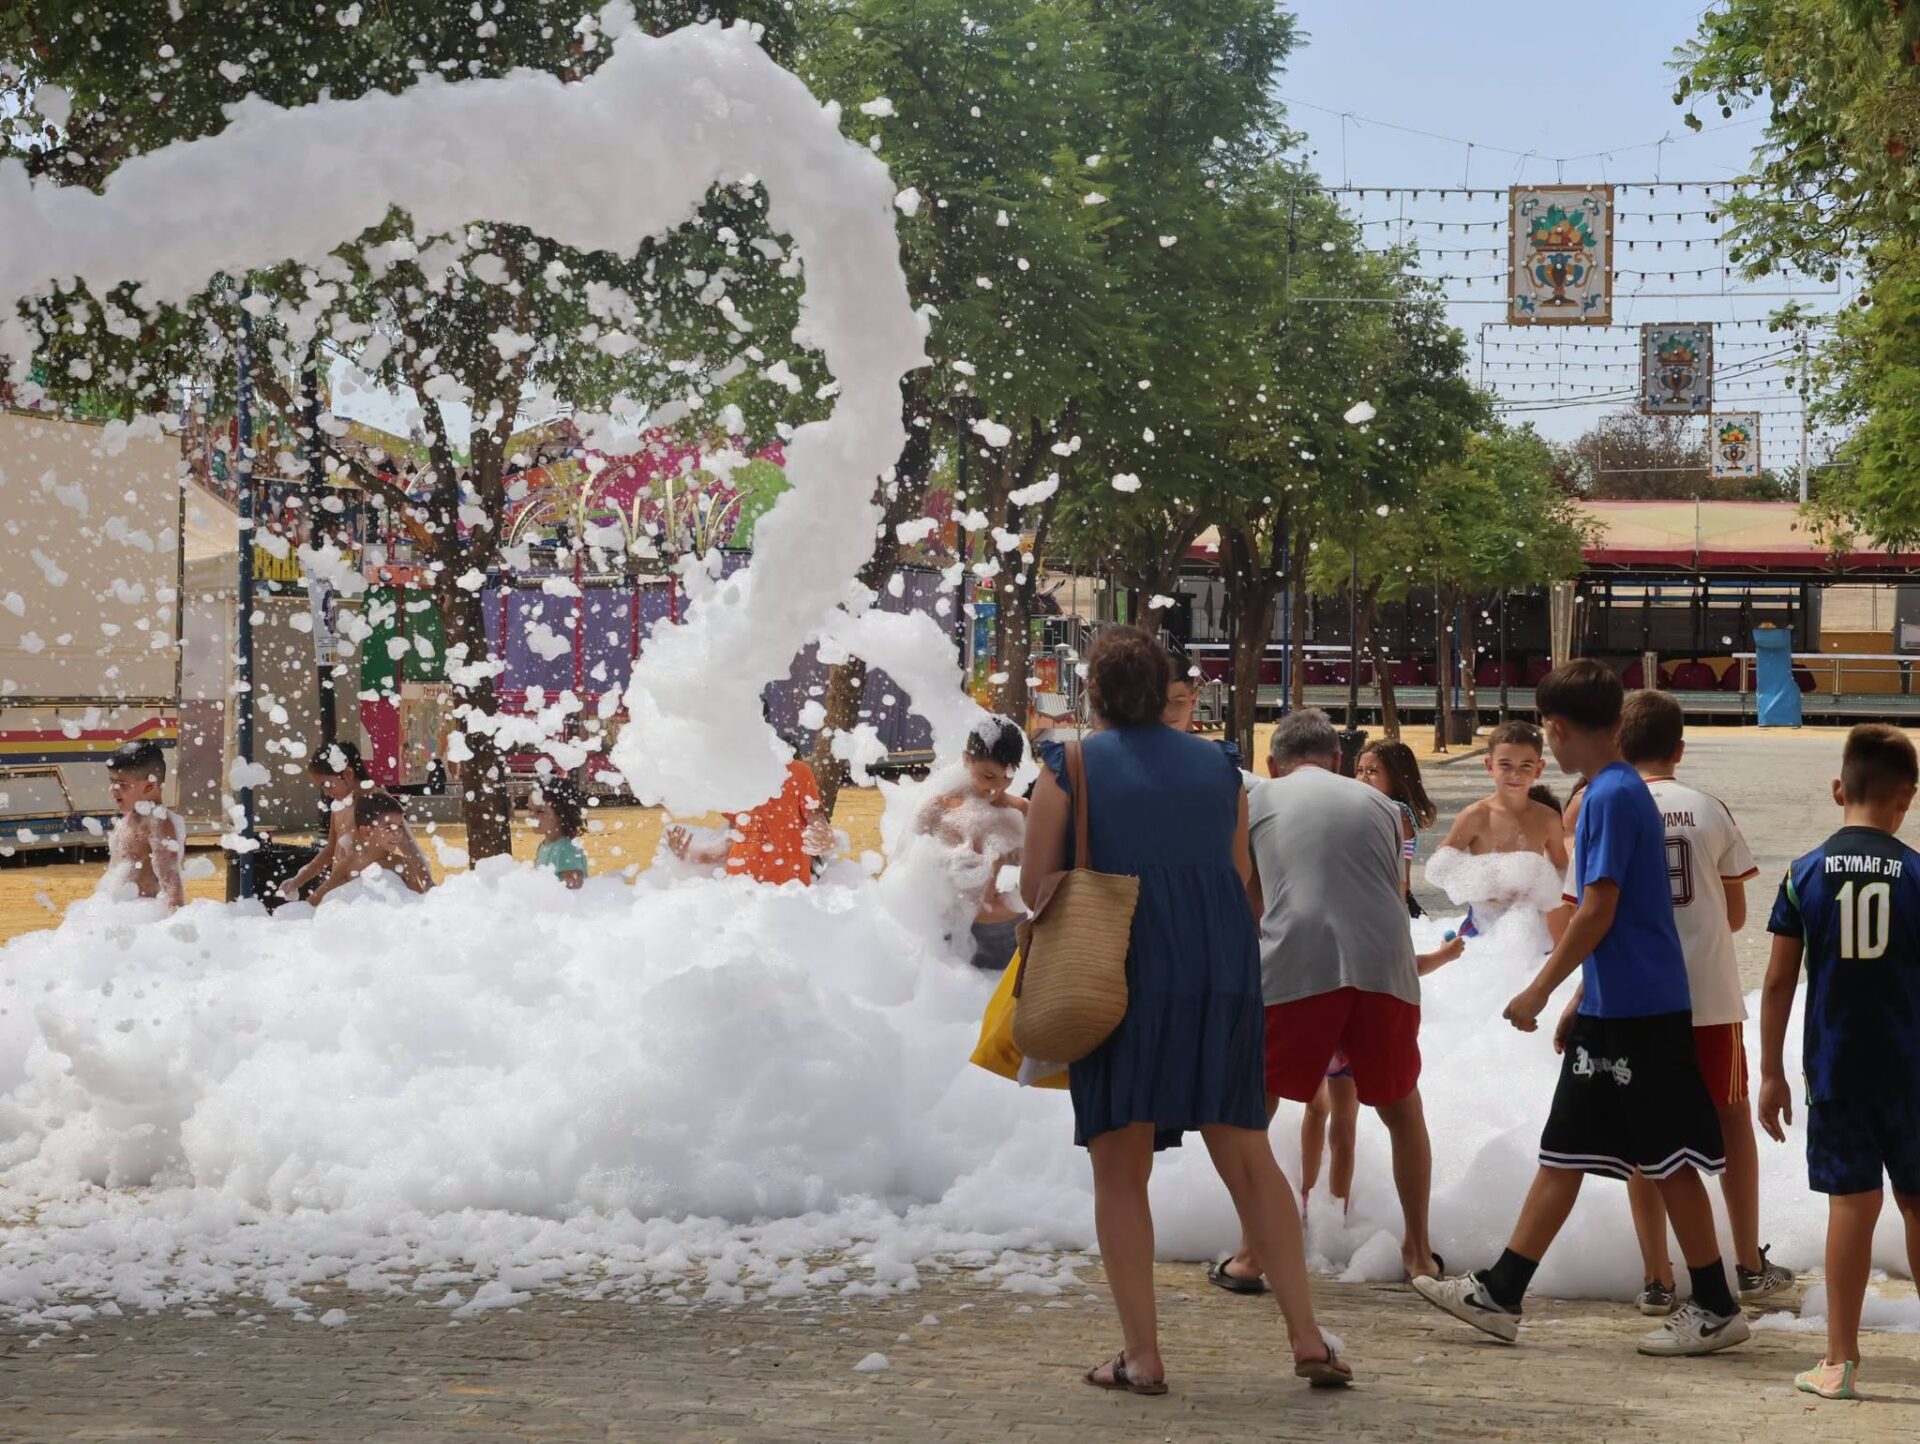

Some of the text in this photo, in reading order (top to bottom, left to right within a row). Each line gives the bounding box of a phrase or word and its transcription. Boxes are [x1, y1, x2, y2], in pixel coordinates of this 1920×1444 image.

[1825, 855, 1902, 879] NEYMAR JR
[1835, 880, 1890, 959] 10
